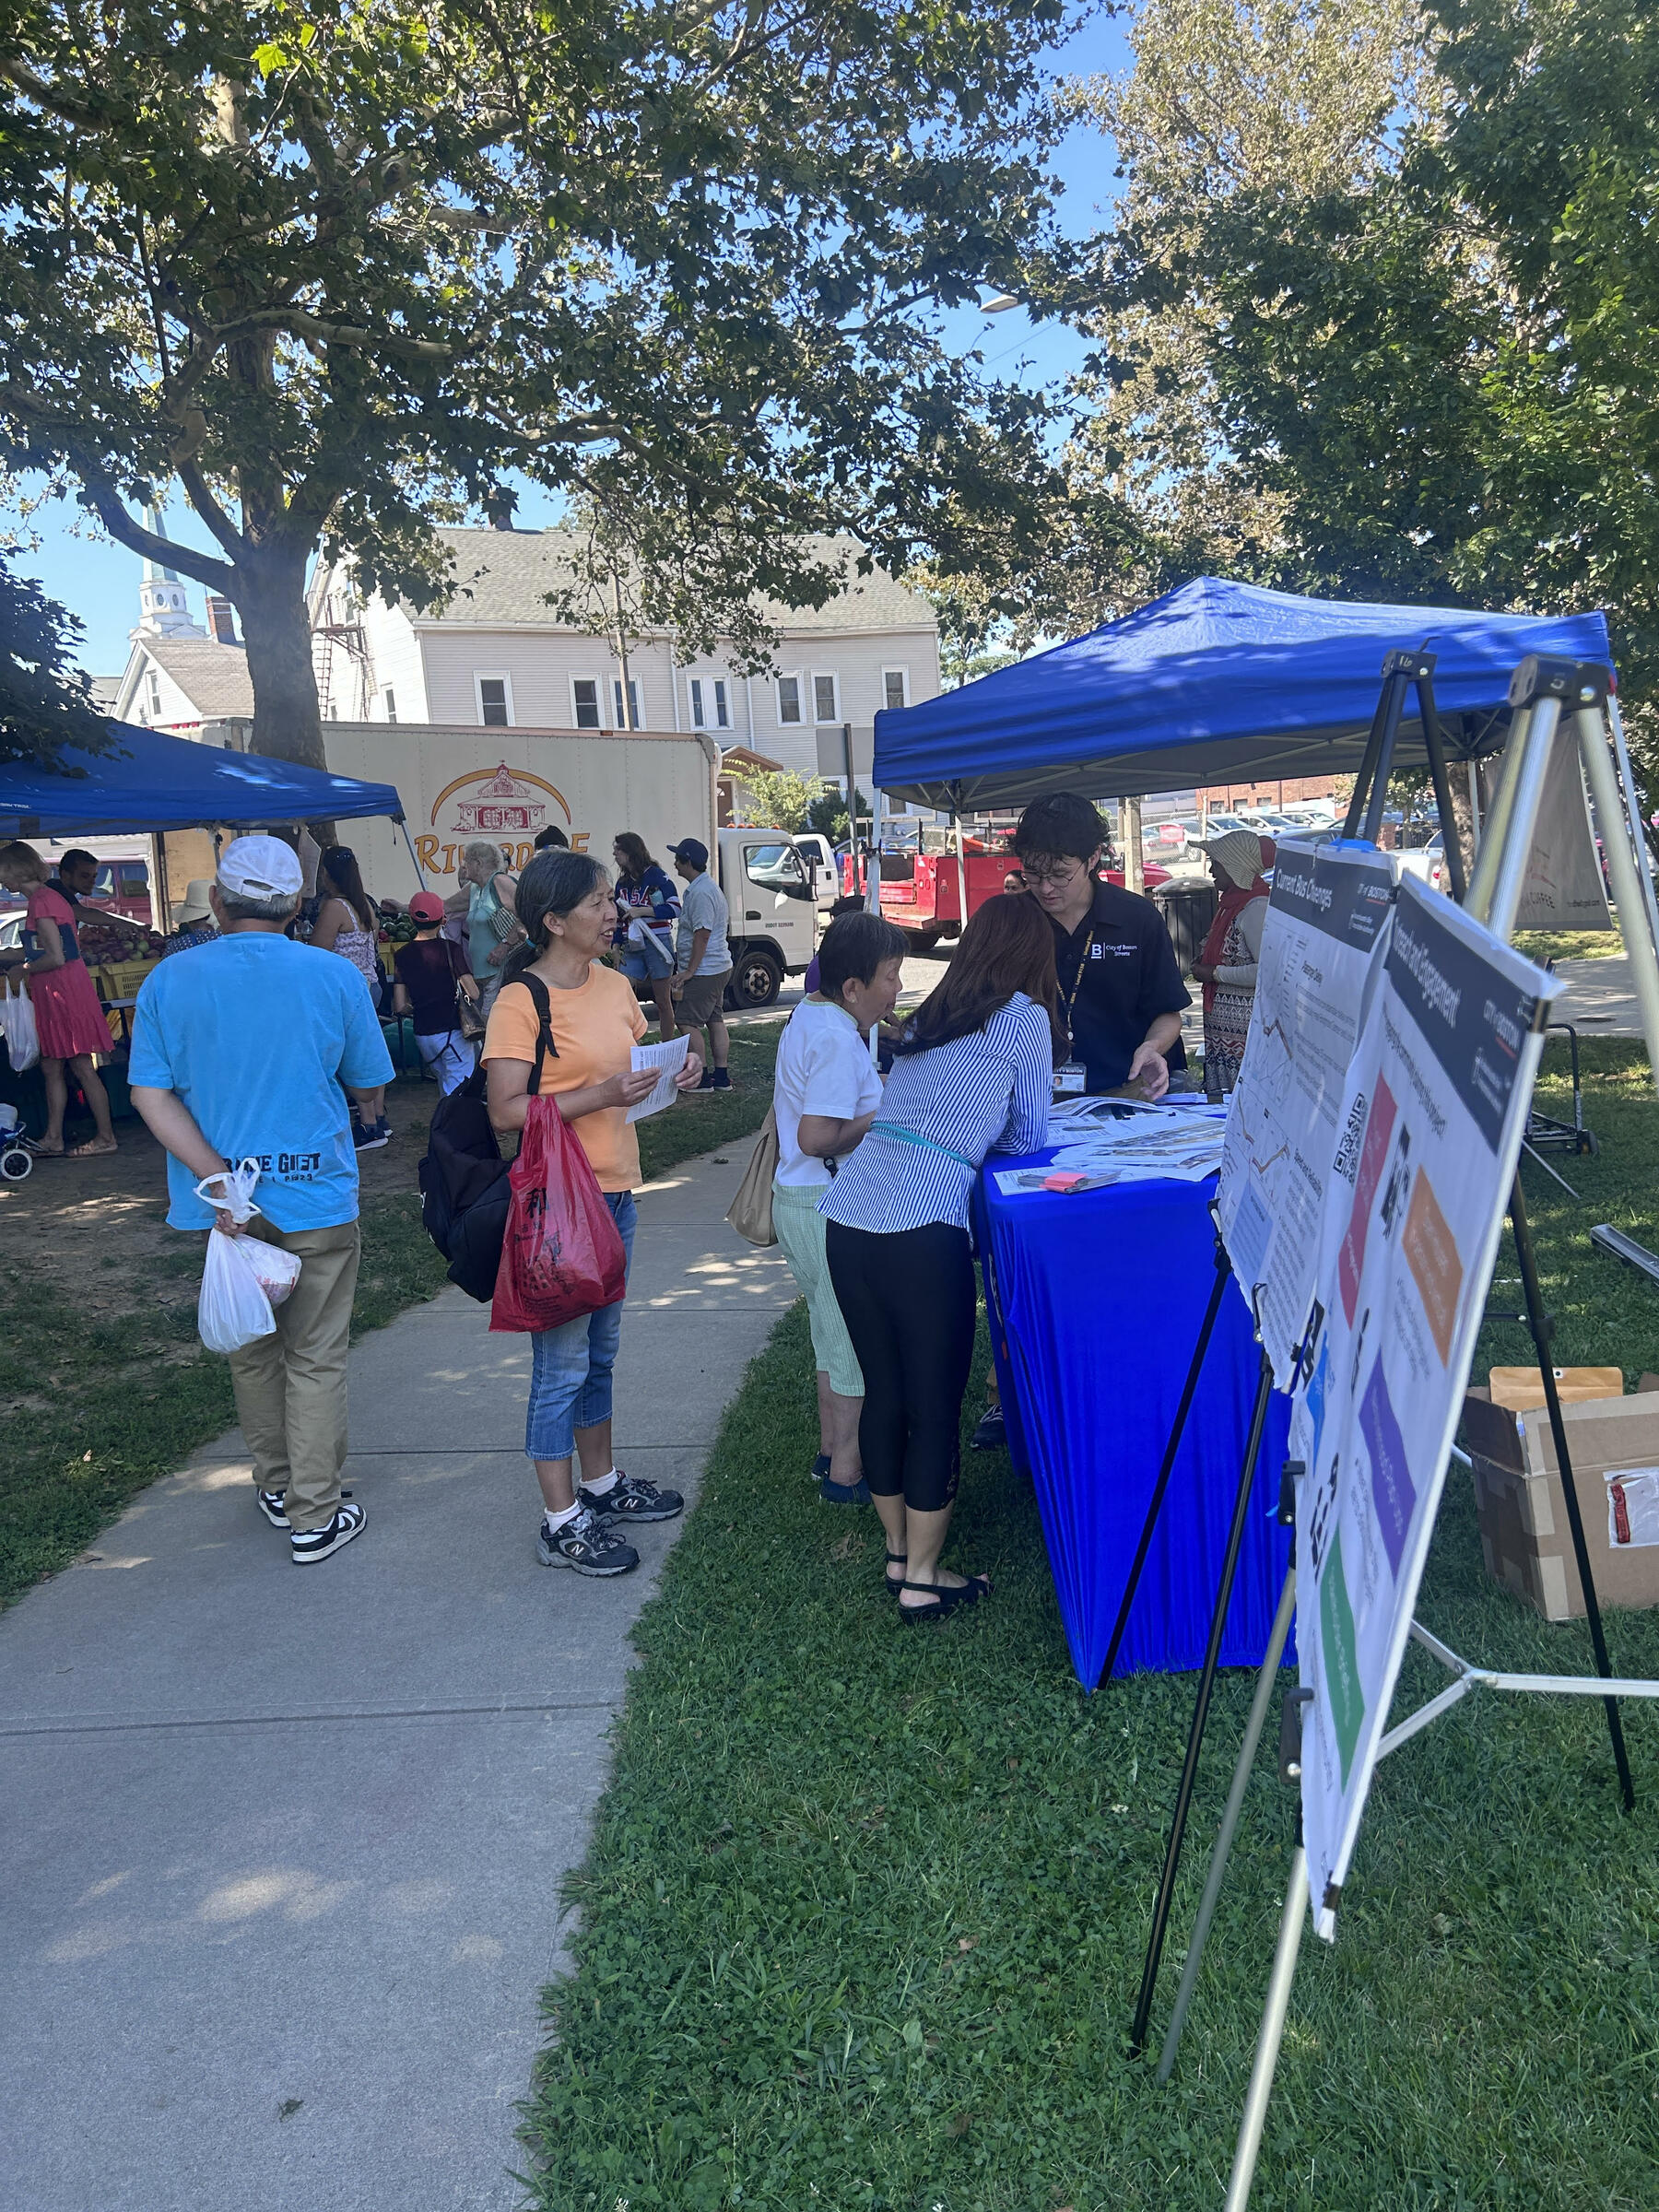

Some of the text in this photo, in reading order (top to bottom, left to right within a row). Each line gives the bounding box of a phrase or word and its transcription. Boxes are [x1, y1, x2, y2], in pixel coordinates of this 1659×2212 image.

[1277, 868, 1333, 912] Current Bus Changes
[1091, 944, 1102, 955] B
[625, 1498, 638, 1508] N
[571, 1544, 584, 1557] N
